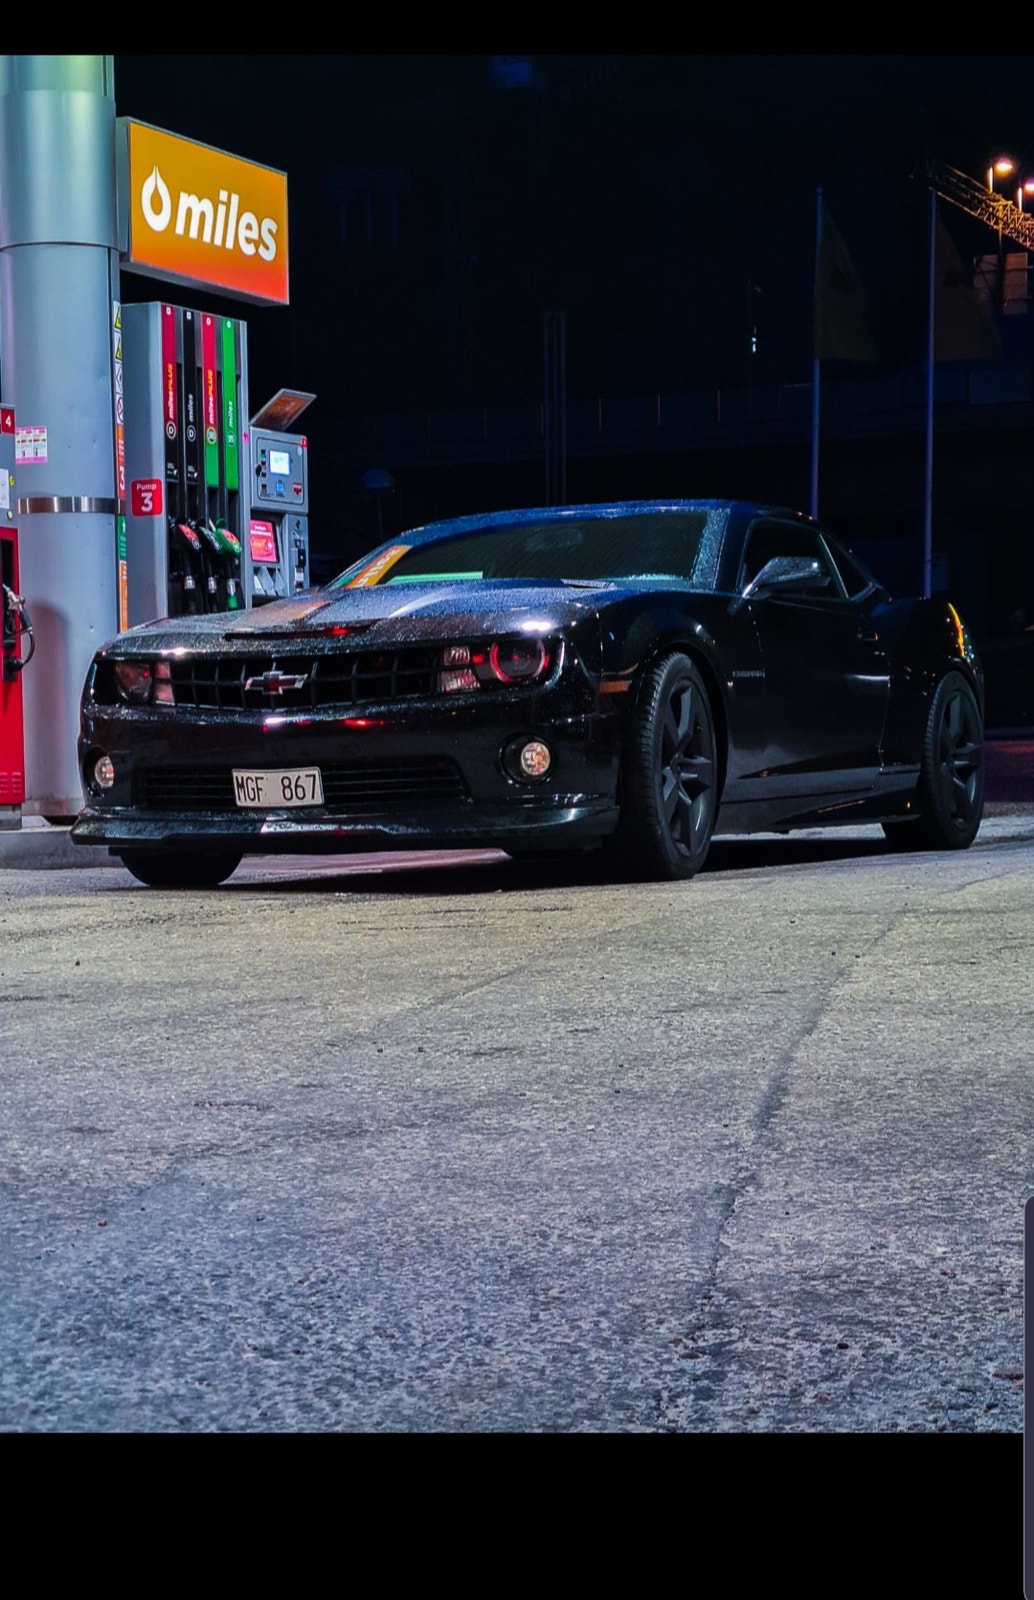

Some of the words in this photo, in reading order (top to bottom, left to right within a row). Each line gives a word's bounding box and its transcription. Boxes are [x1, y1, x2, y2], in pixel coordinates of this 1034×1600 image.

[174, 188, 278, 262] miles
[207, 369, 215, 425] milesPLUS
[5, 414, 12, 428] 4
[136, 483, 157, 491] Pump
[141, 491, 153, 513] 3
[235, 775, 264, 803] MGF
[280, 773, 317, 802] 867
